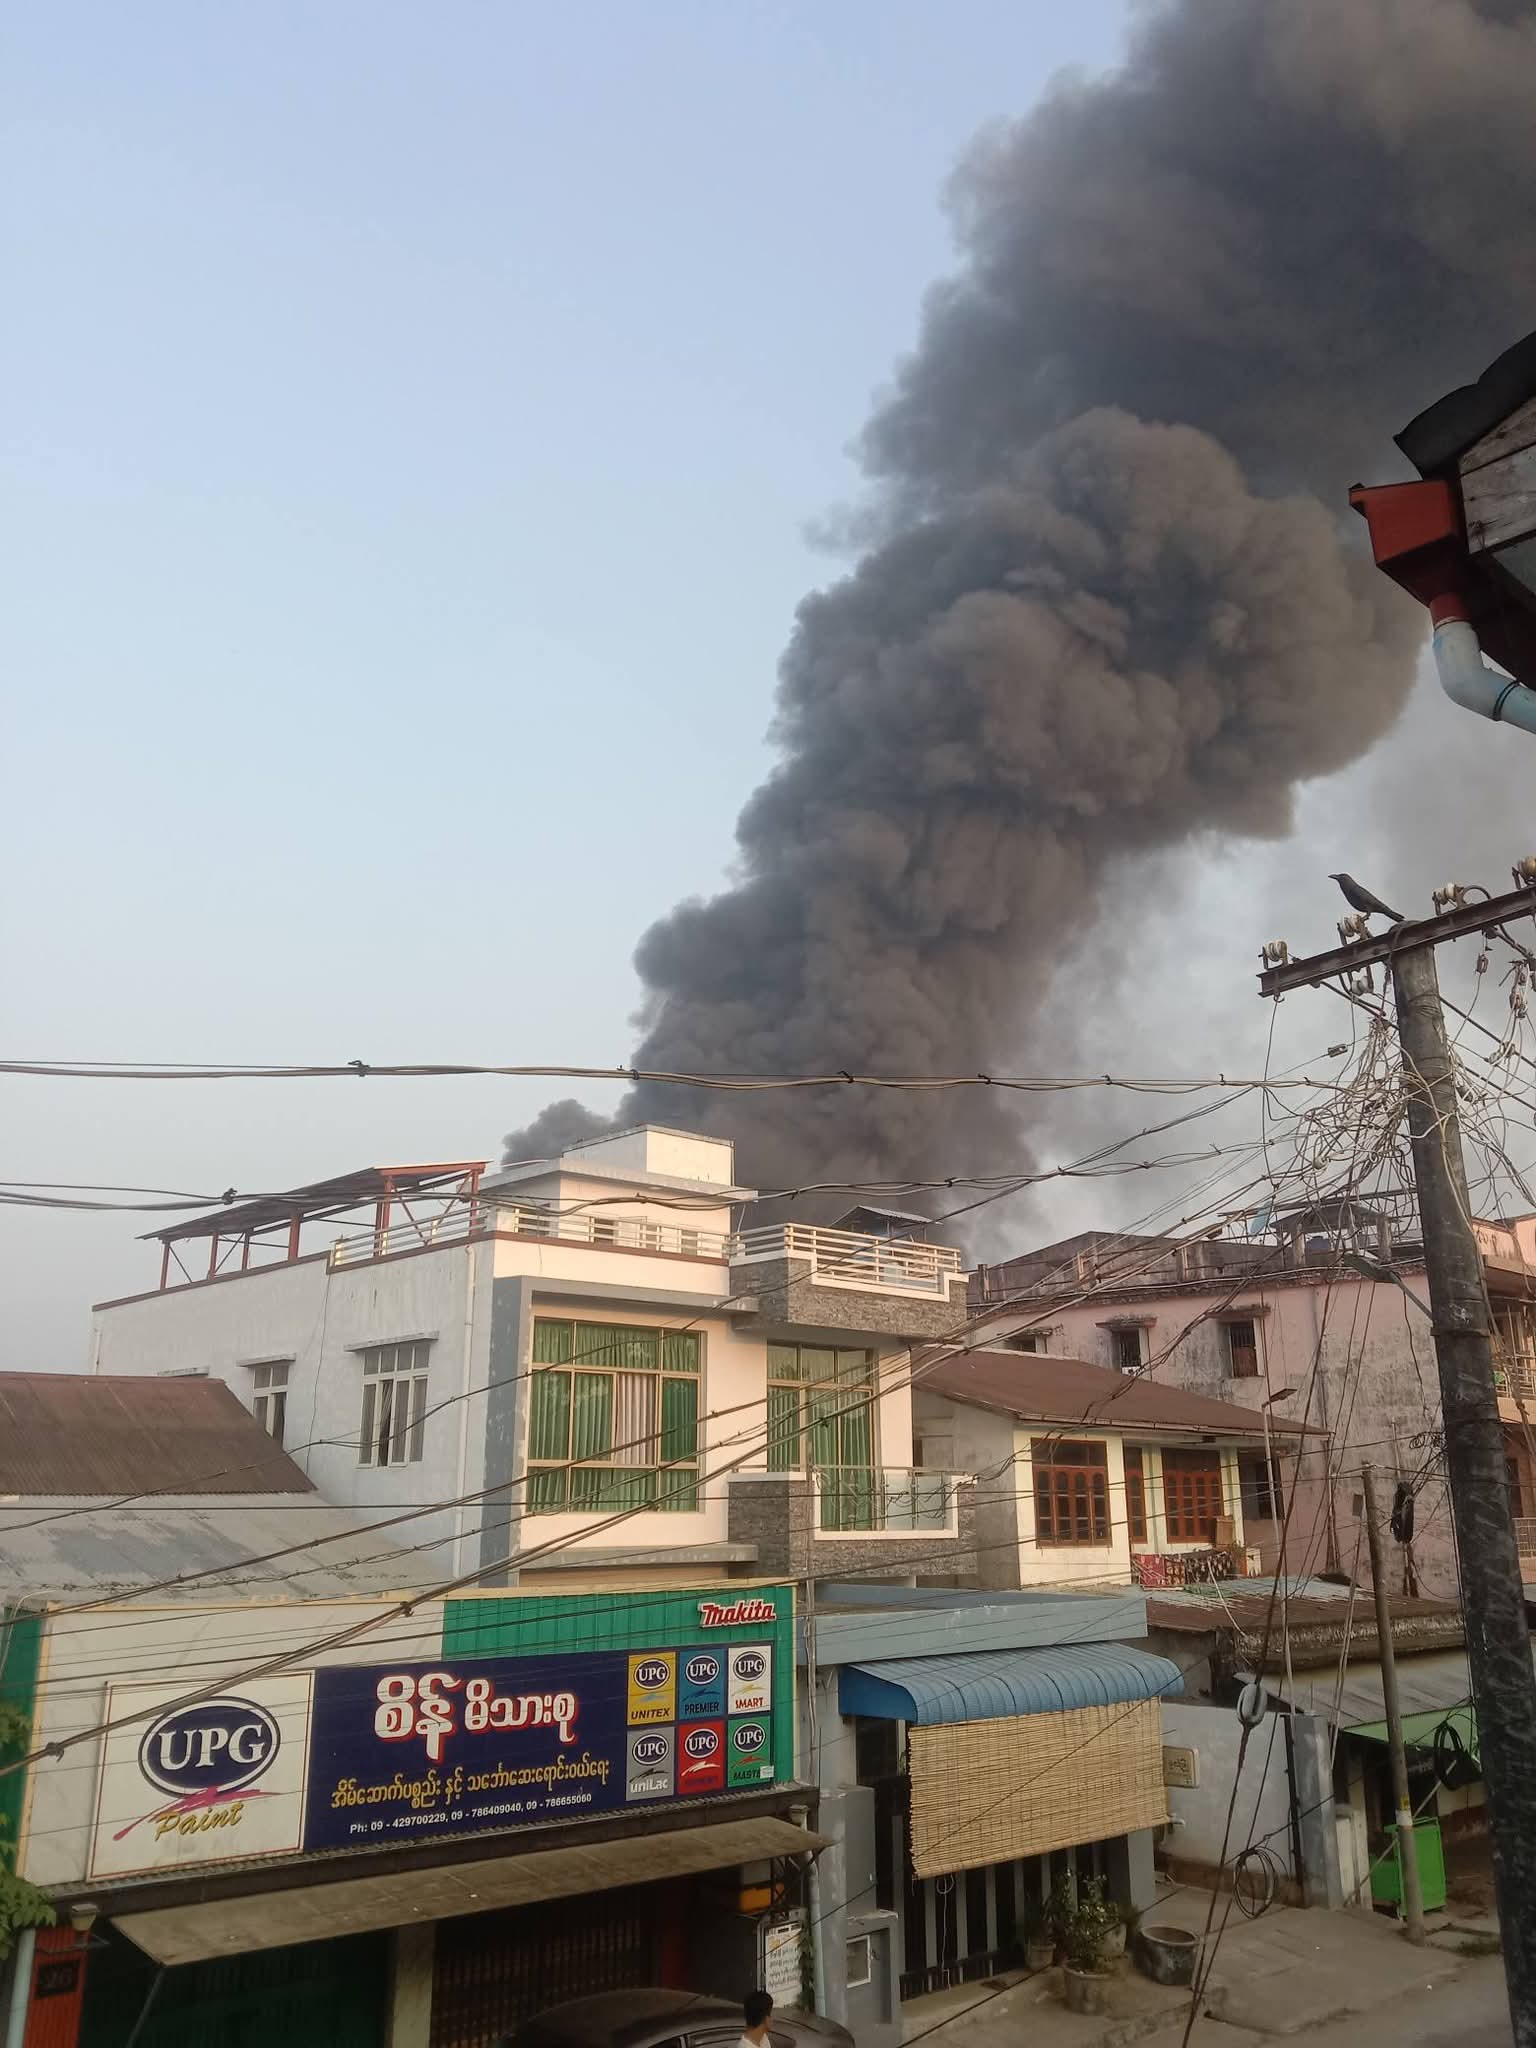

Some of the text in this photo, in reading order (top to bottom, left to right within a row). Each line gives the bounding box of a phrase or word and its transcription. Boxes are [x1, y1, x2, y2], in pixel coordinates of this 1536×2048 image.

[700, 1599, 776, 1627] Makita
[689, 1663, 717, 1678] UPG
[737, 1658, 764, 1673] UPG
[638, 1666, 667, 1682] UPG
[684, 1702, 720, 1714] PREMIER
[735, 1697, 764, 1709] SMART
[374, 1672, 577, 1760] စိန် မိသားစု
[631, 1707, 670, 1720] UNITEX
[689, 1736, 715, 1750] UPG
[737, 1730, 762, 1745] UPG
[158, 1723, 265, 1771] UPG
[637, 1743, 666, 1757] UPG
[631, 1779, 668, 1793] uniLac
[154, 1801, 245, 1842] Paint
[349, 1823, 368, 1834] Ph:
[370, 1820, 383, 1831] 09
[451, 1810, 463, 1821] 09
[526, 1800, 537, 1810] 09
